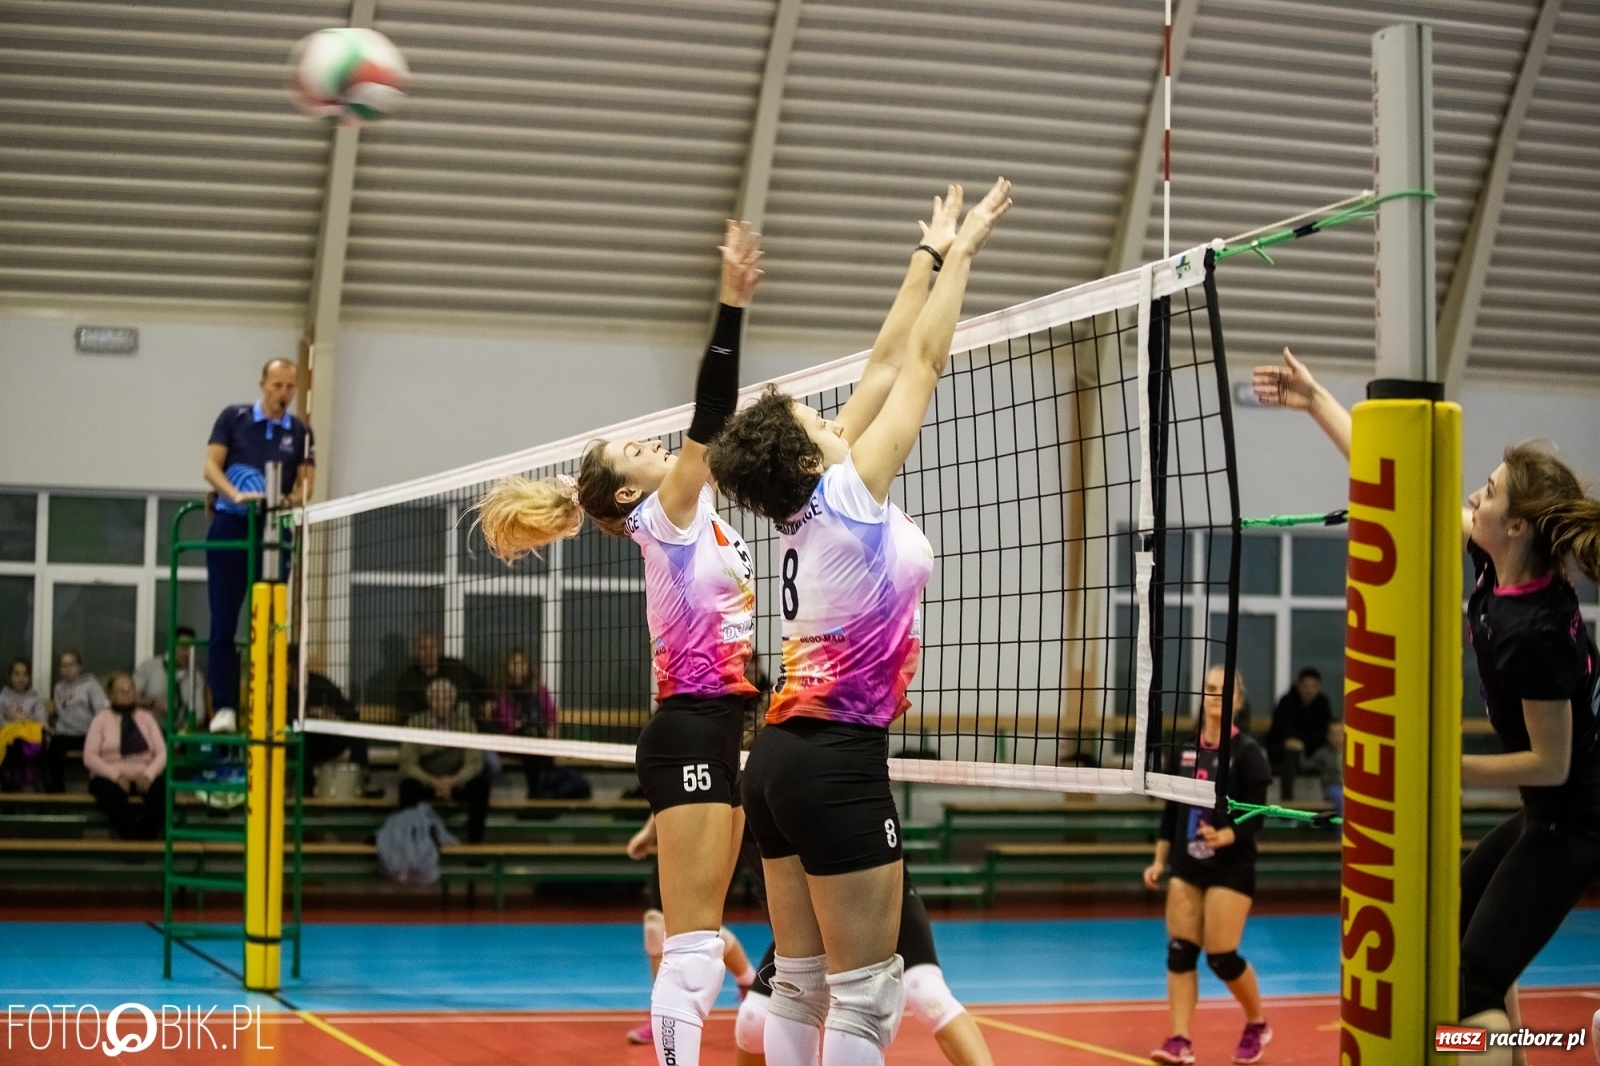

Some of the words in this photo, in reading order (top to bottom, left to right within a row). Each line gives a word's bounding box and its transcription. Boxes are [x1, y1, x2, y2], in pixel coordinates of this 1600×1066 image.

[782, 548, 799, 620] 8
[683, 763, 712, 793] 55
[884, 818, 898, 848] 8
